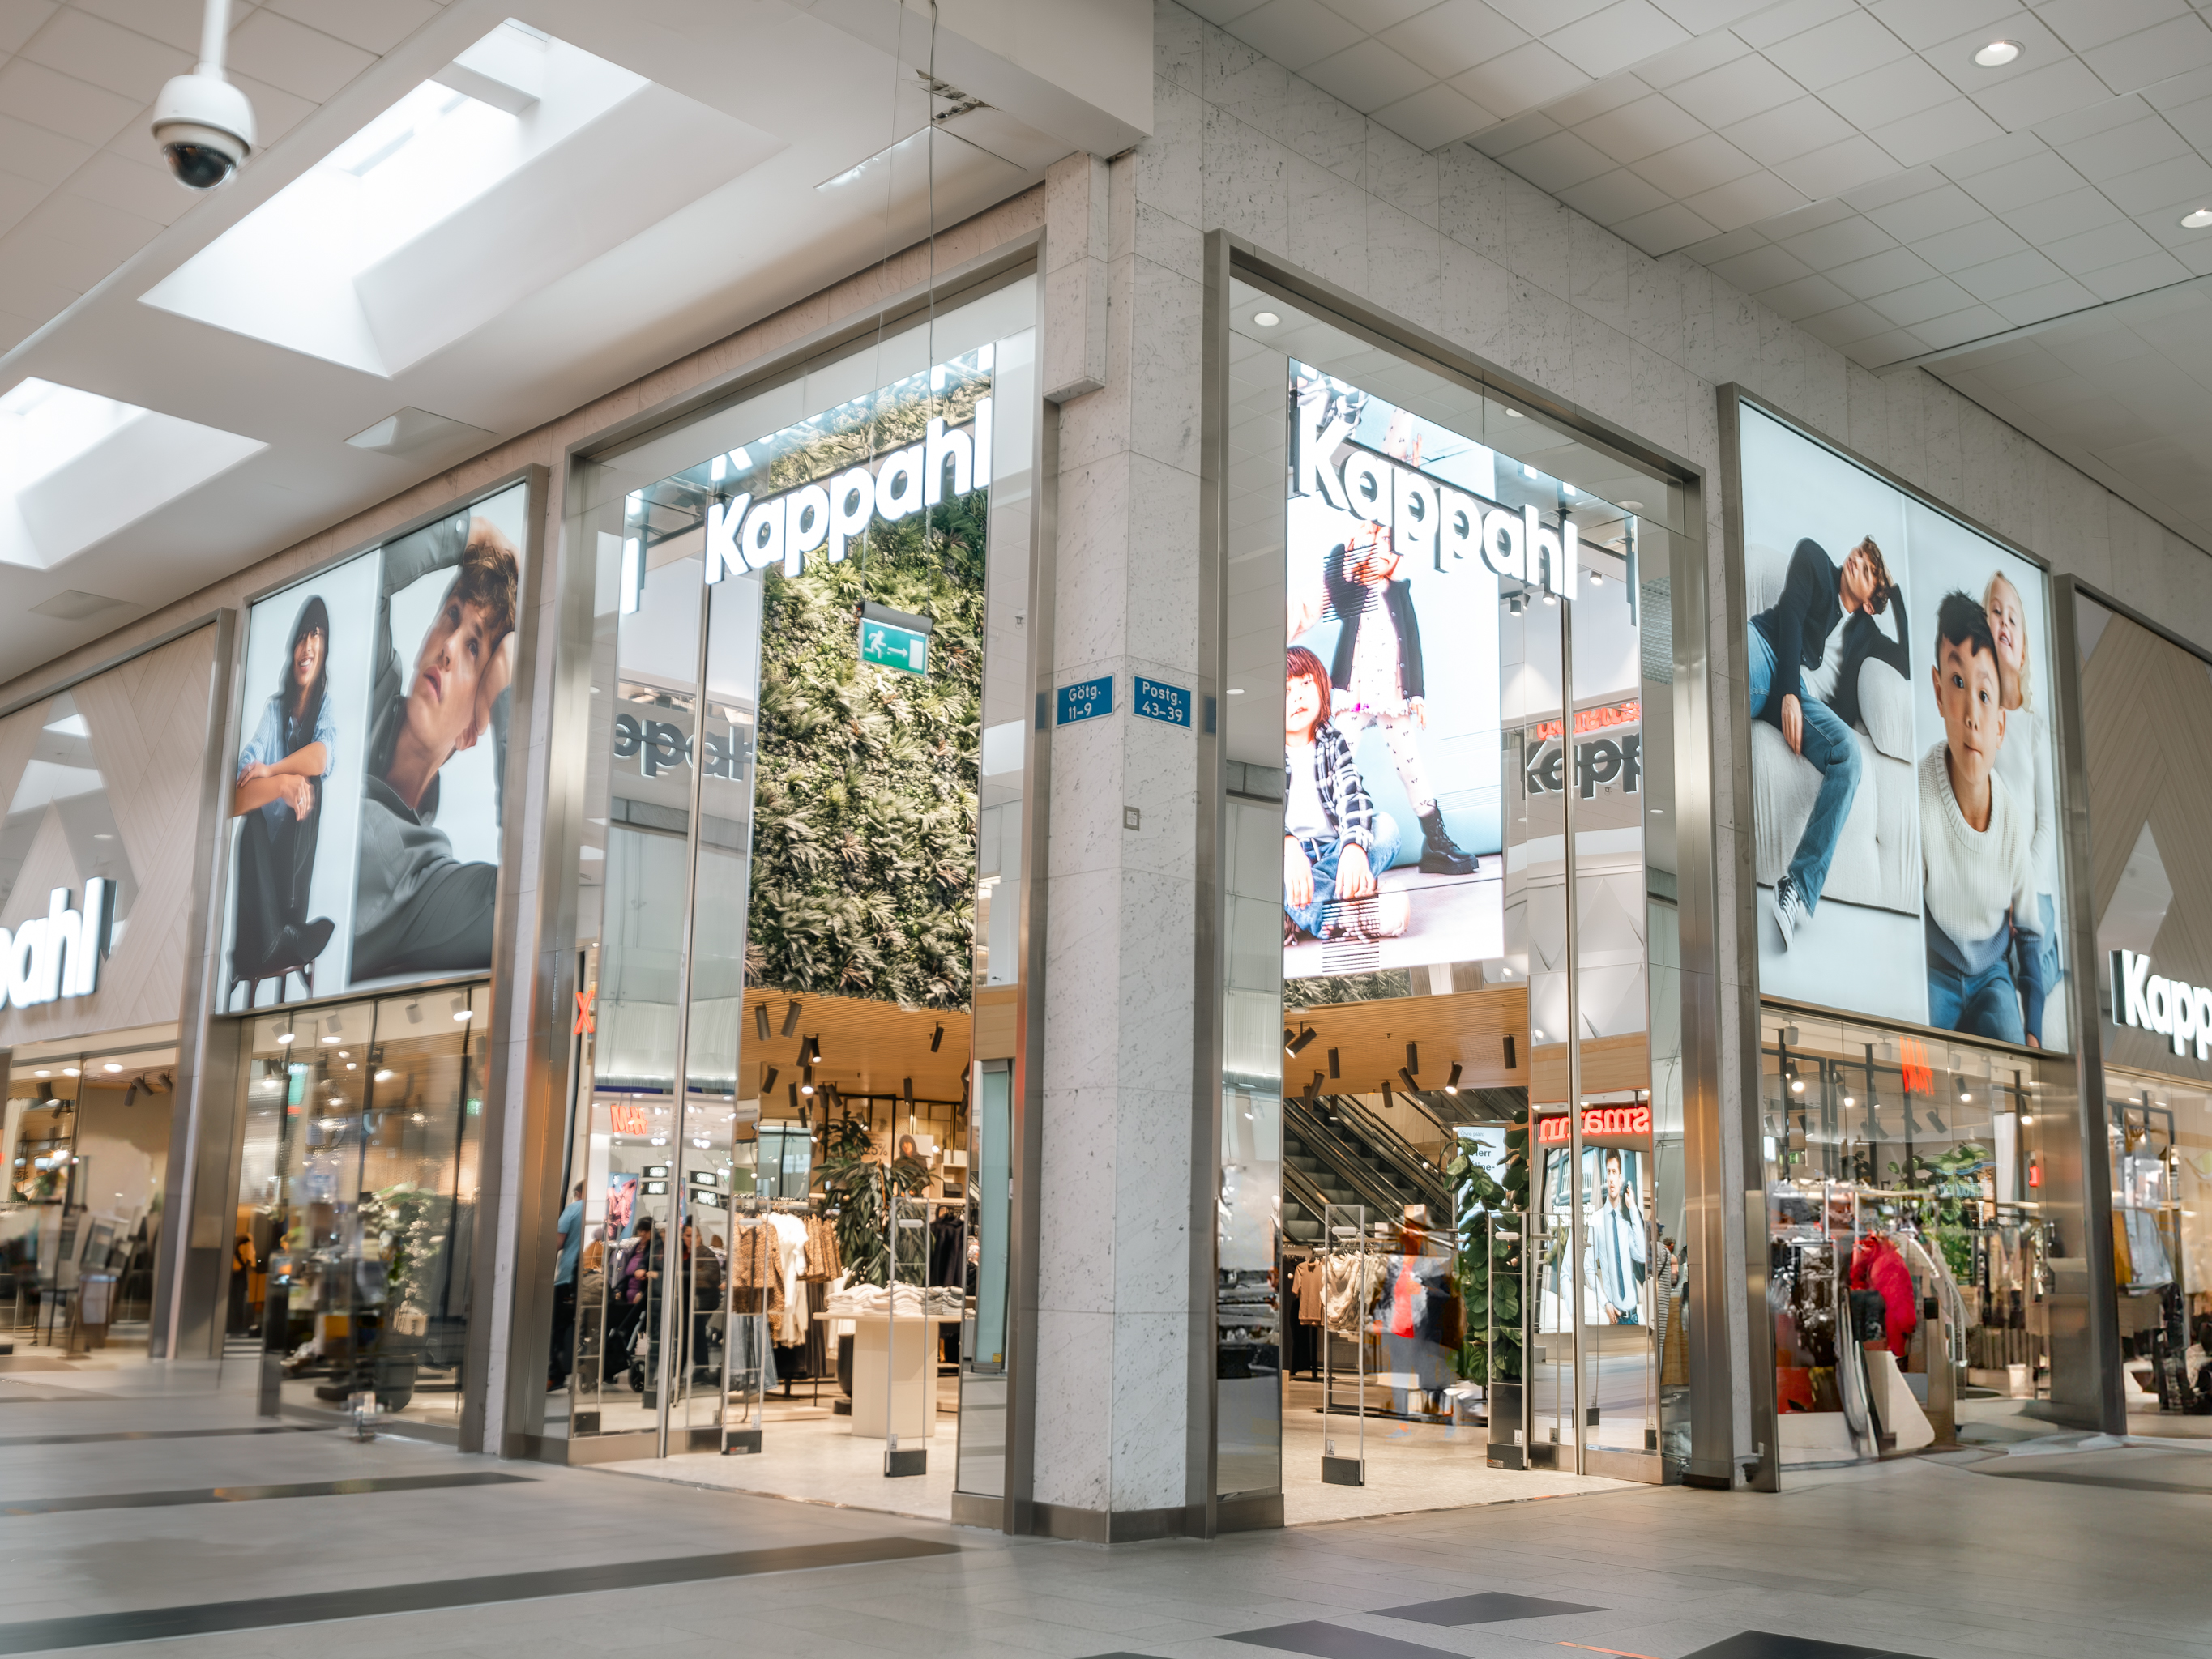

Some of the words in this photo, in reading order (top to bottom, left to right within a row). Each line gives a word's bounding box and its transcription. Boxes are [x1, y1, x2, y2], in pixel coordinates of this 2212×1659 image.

[704, 396, 993, 585] Kappahl
[1294, 402, 1578, 601] Kappahl
[1068, 684, 1102, 702] Götg.
[1142, 680, 1183, 706] Postg.
[1068, 702, 1093, 720] 11-9
[1142, 700, 1184, 723] 43-39
